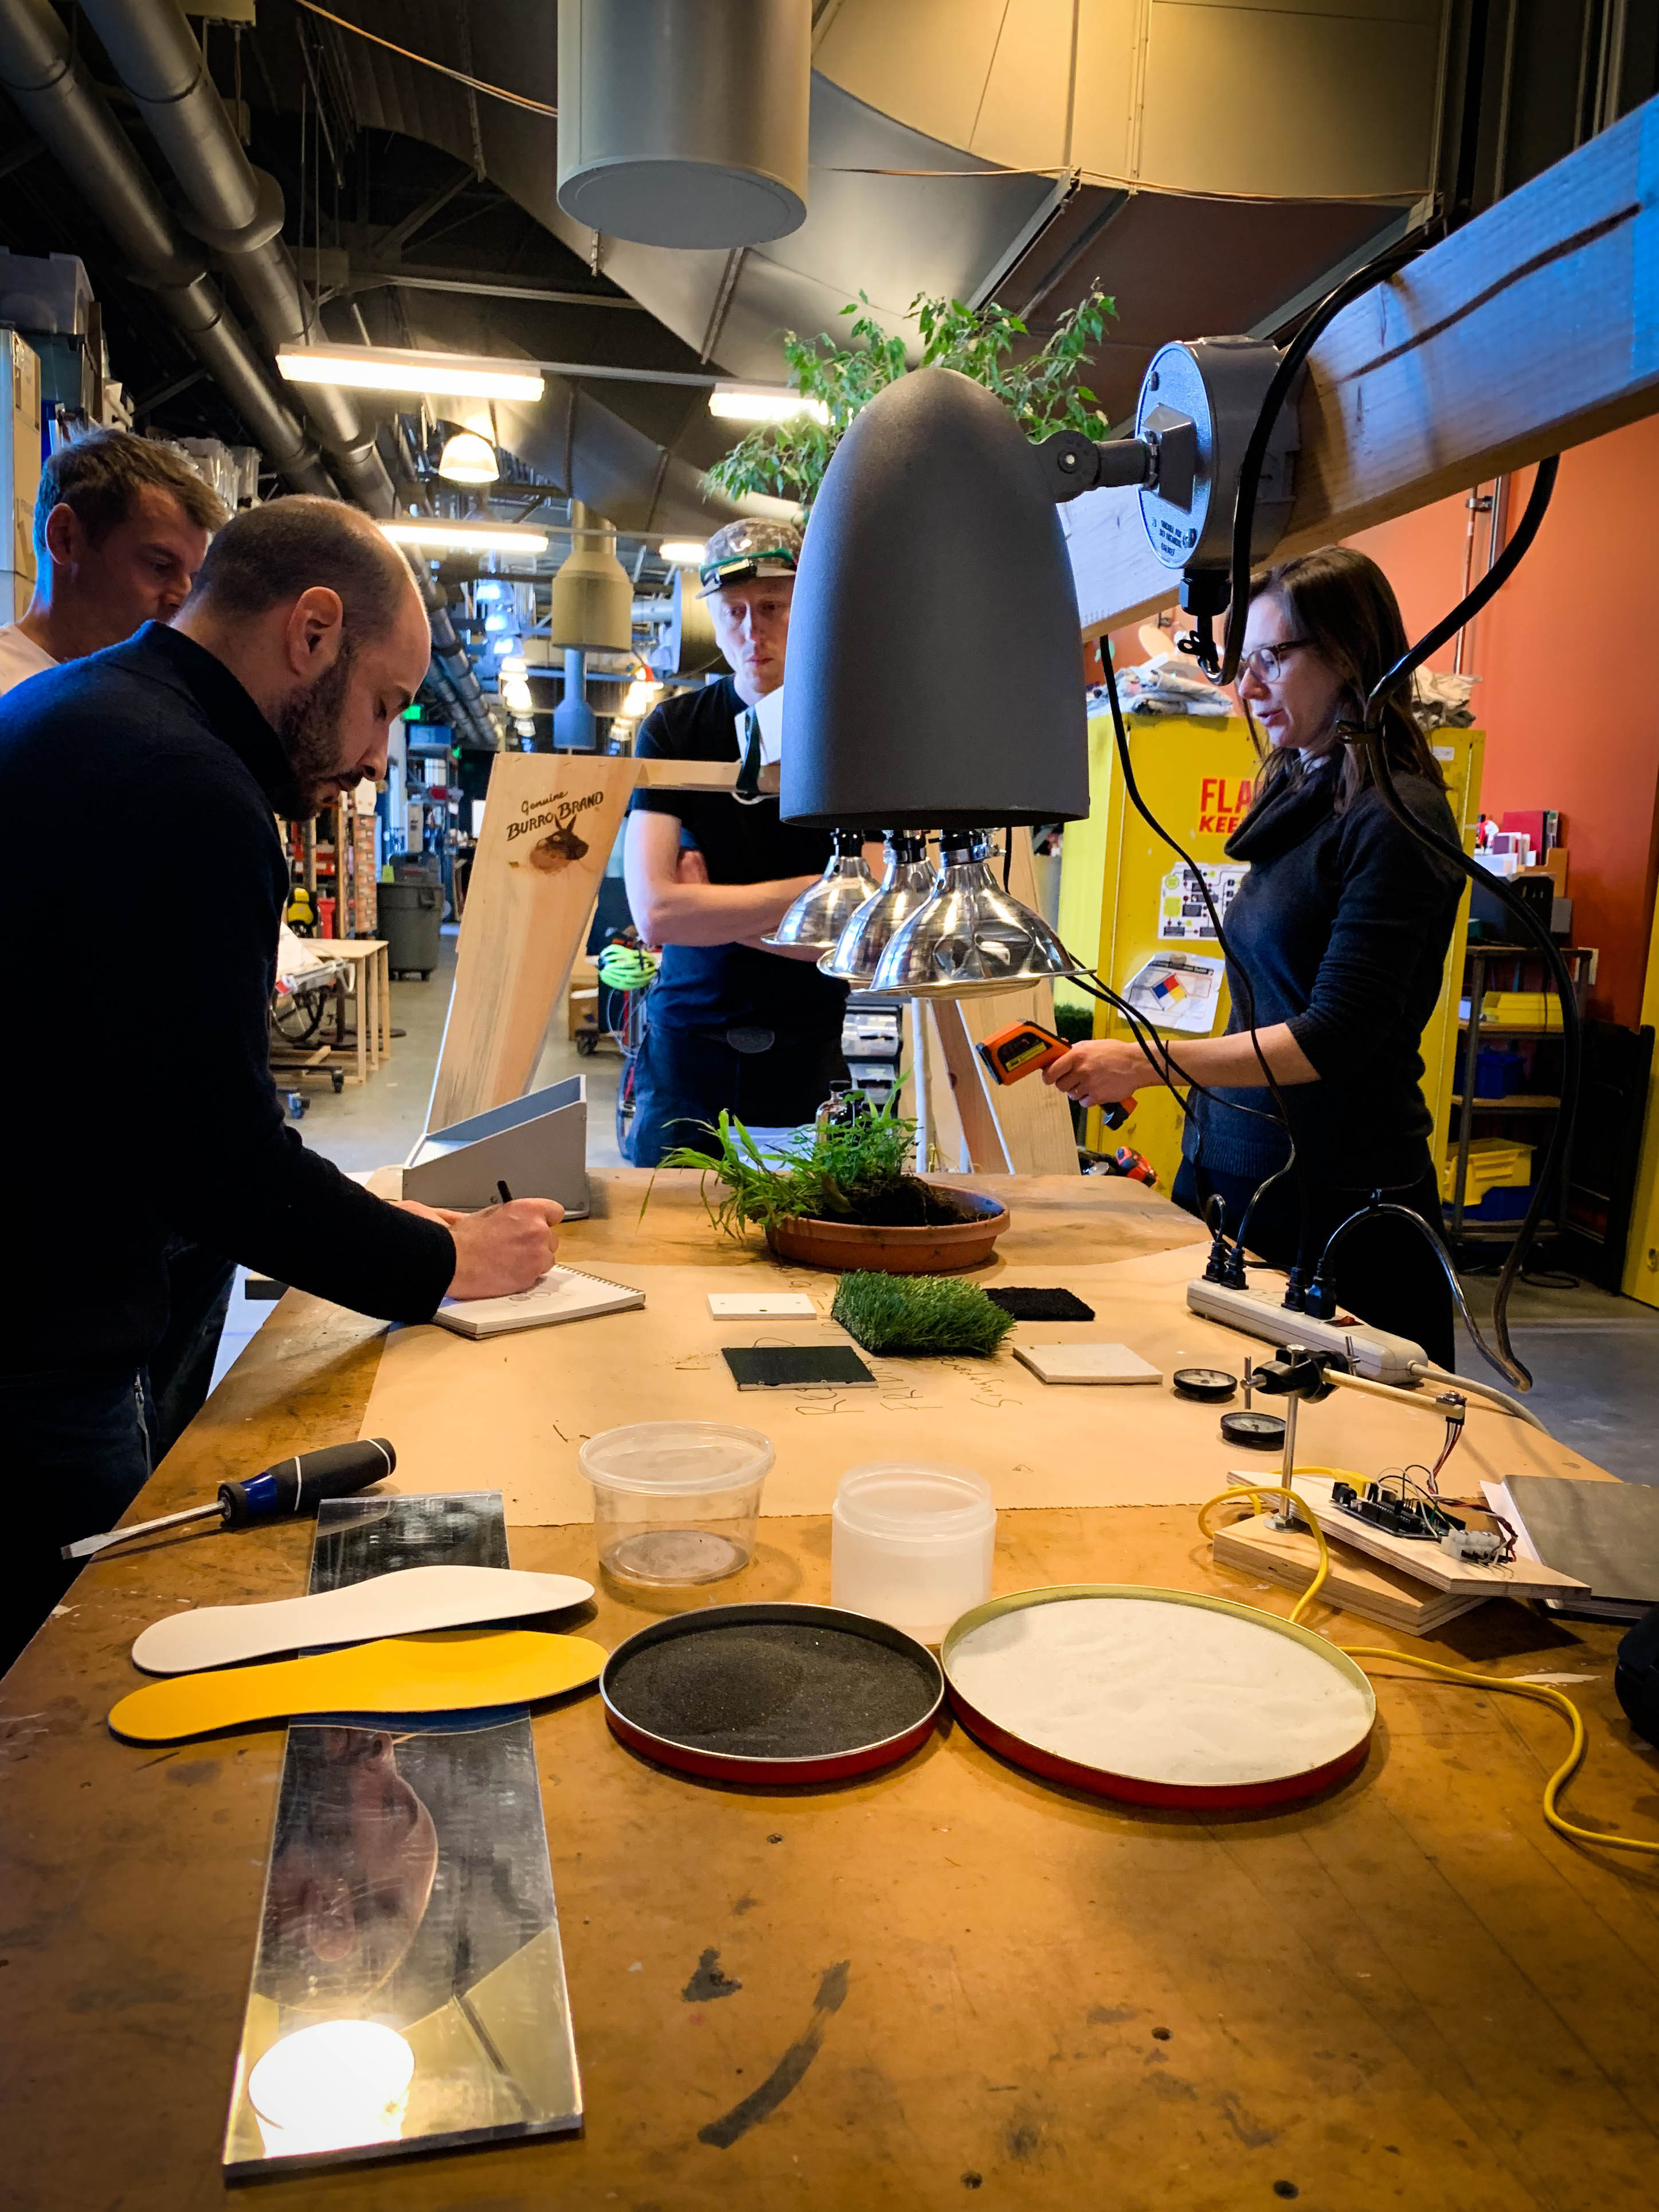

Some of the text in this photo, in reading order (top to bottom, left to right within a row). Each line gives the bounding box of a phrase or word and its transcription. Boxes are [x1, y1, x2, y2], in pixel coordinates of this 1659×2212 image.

[521, 790, 569, 815] Genuine
[507, 791, 604, 841] BURRO BRAND
[1199, 815, 1246, 834] KEE
